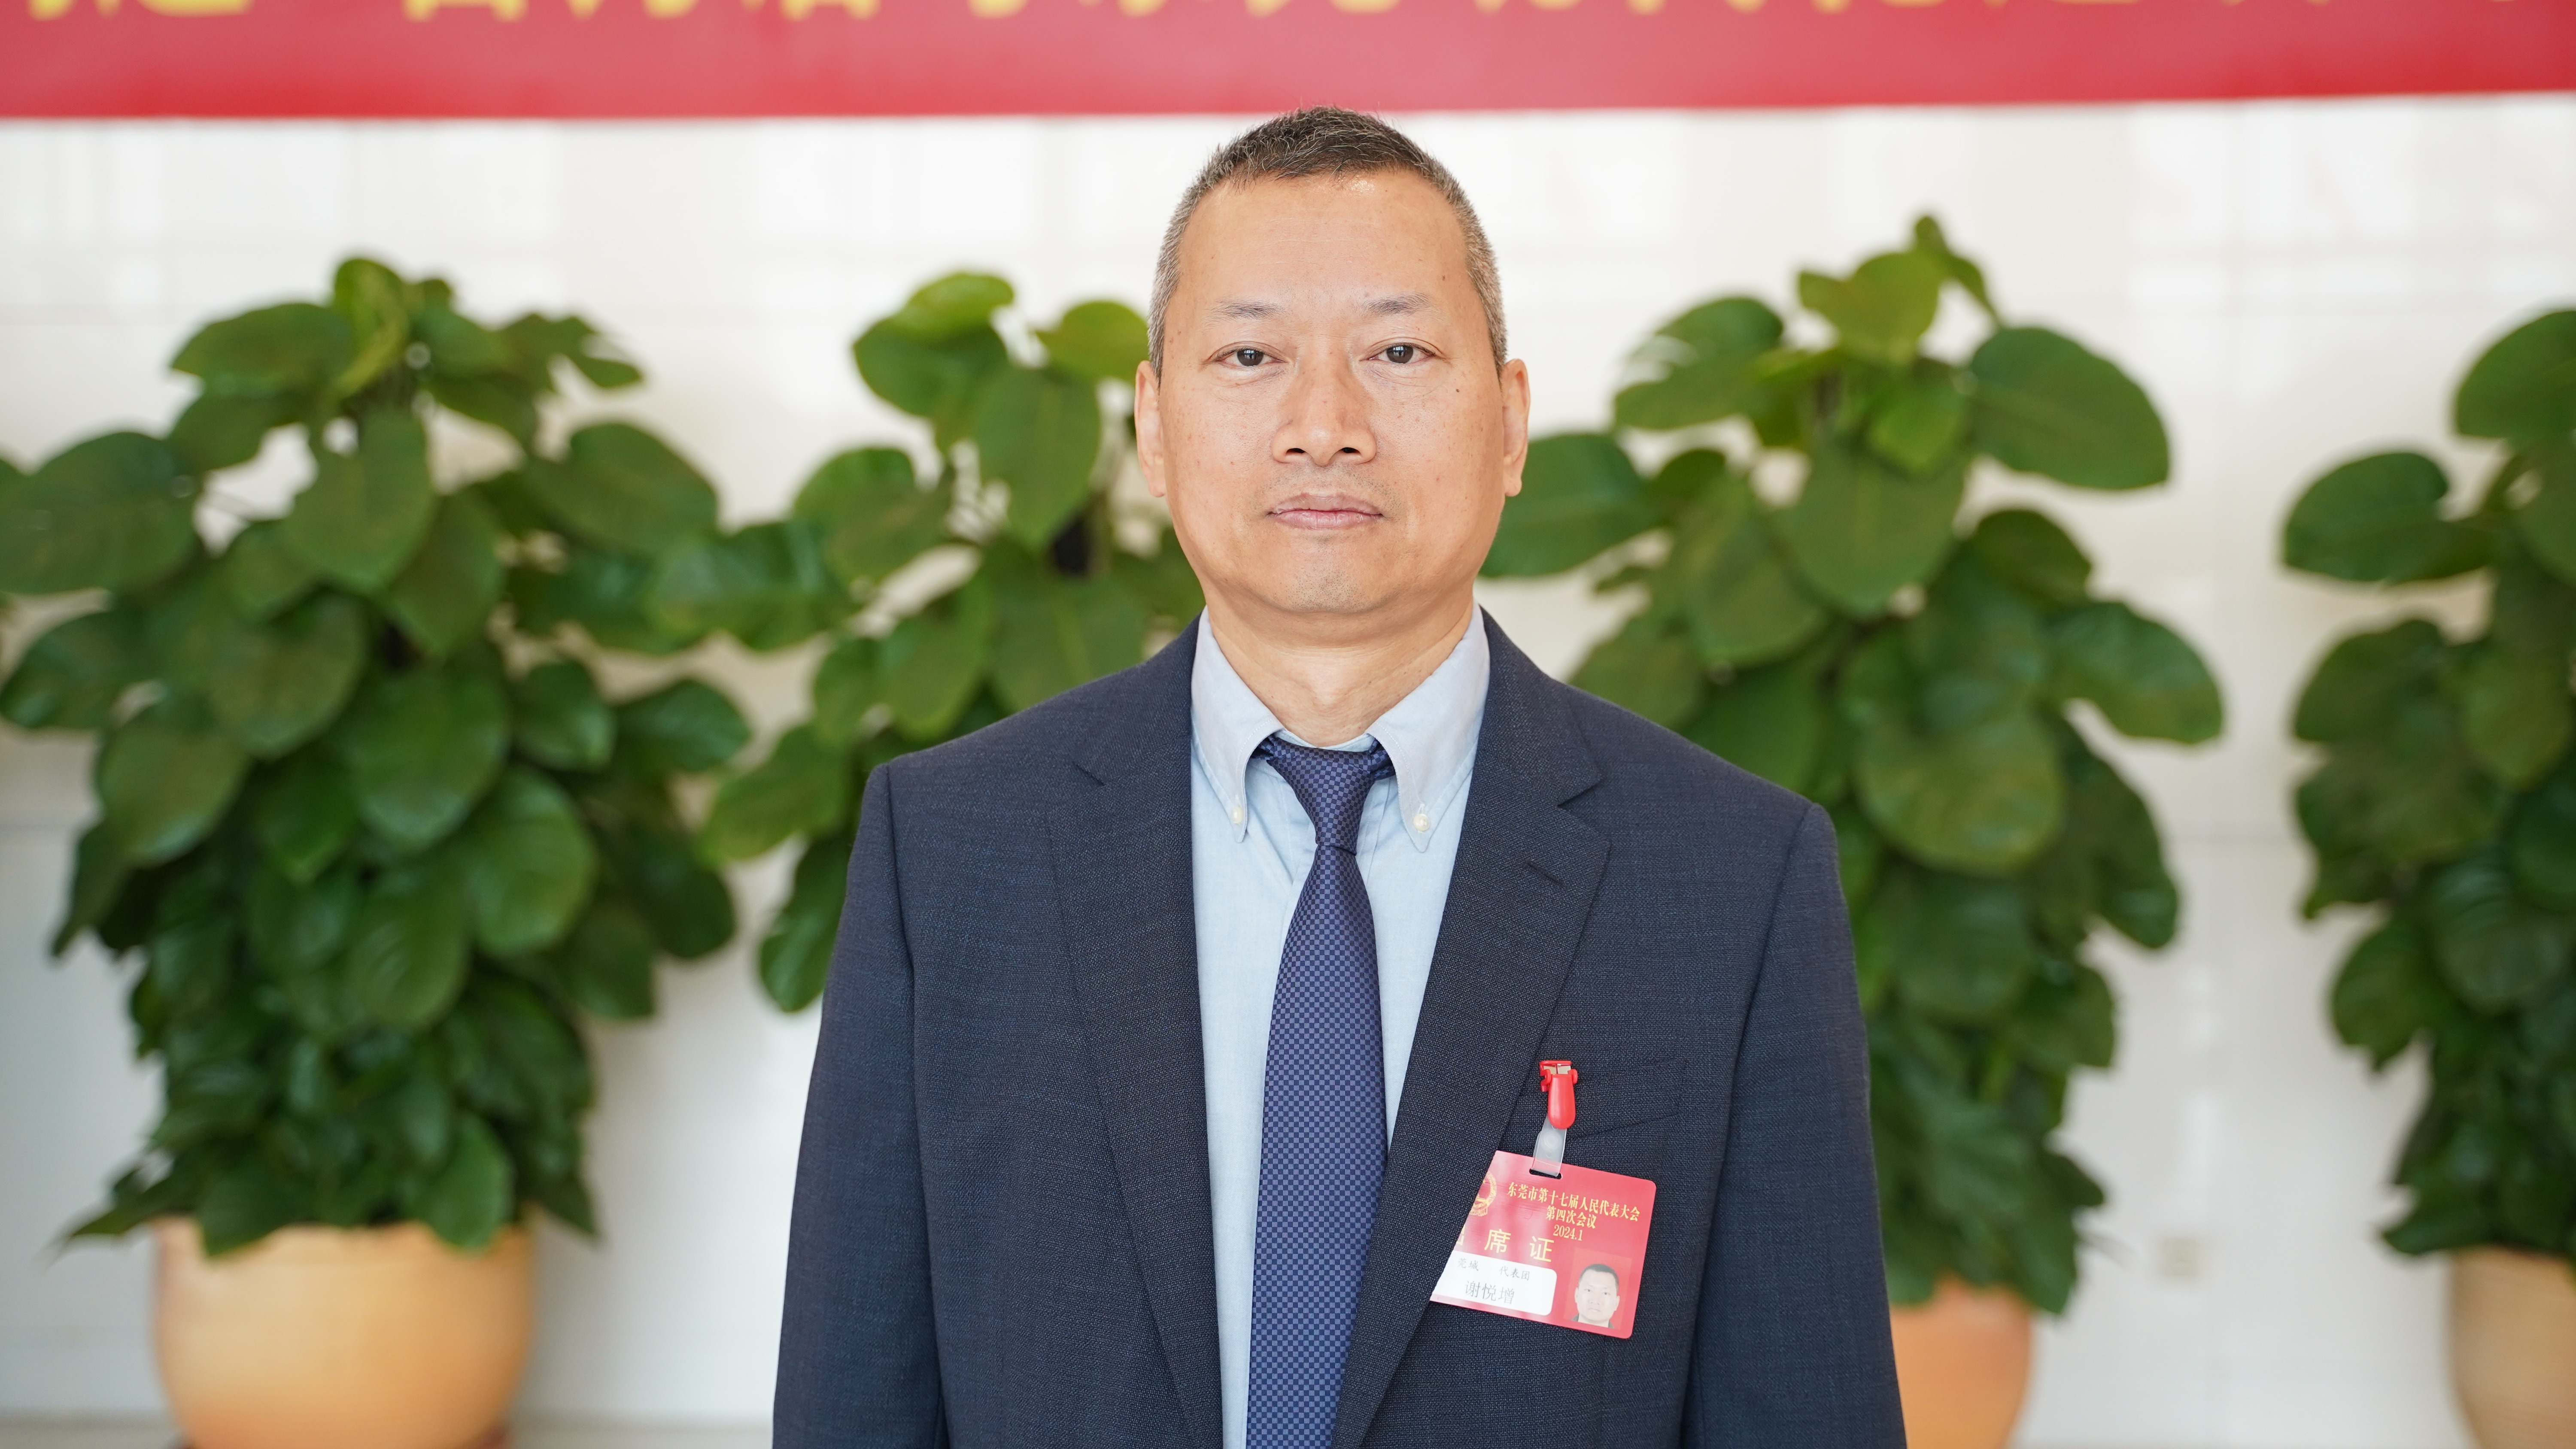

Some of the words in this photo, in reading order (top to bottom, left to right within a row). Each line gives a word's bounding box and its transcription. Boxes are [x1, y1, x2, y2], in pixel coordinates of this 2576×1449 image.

[1507, 1182, 1640, 1222] 东莞市第十七届人民代表大会
[1546, 1205, 1597, 1229] 第四次会议
[1553, 1224, 1583, 1241] 2024.1
[1457, 1258, 1479, 1271] 莞城
[1499, 1266, 1530, 1281] 代表团
[1465, 1280, 1515, 1304] 谢悦增
